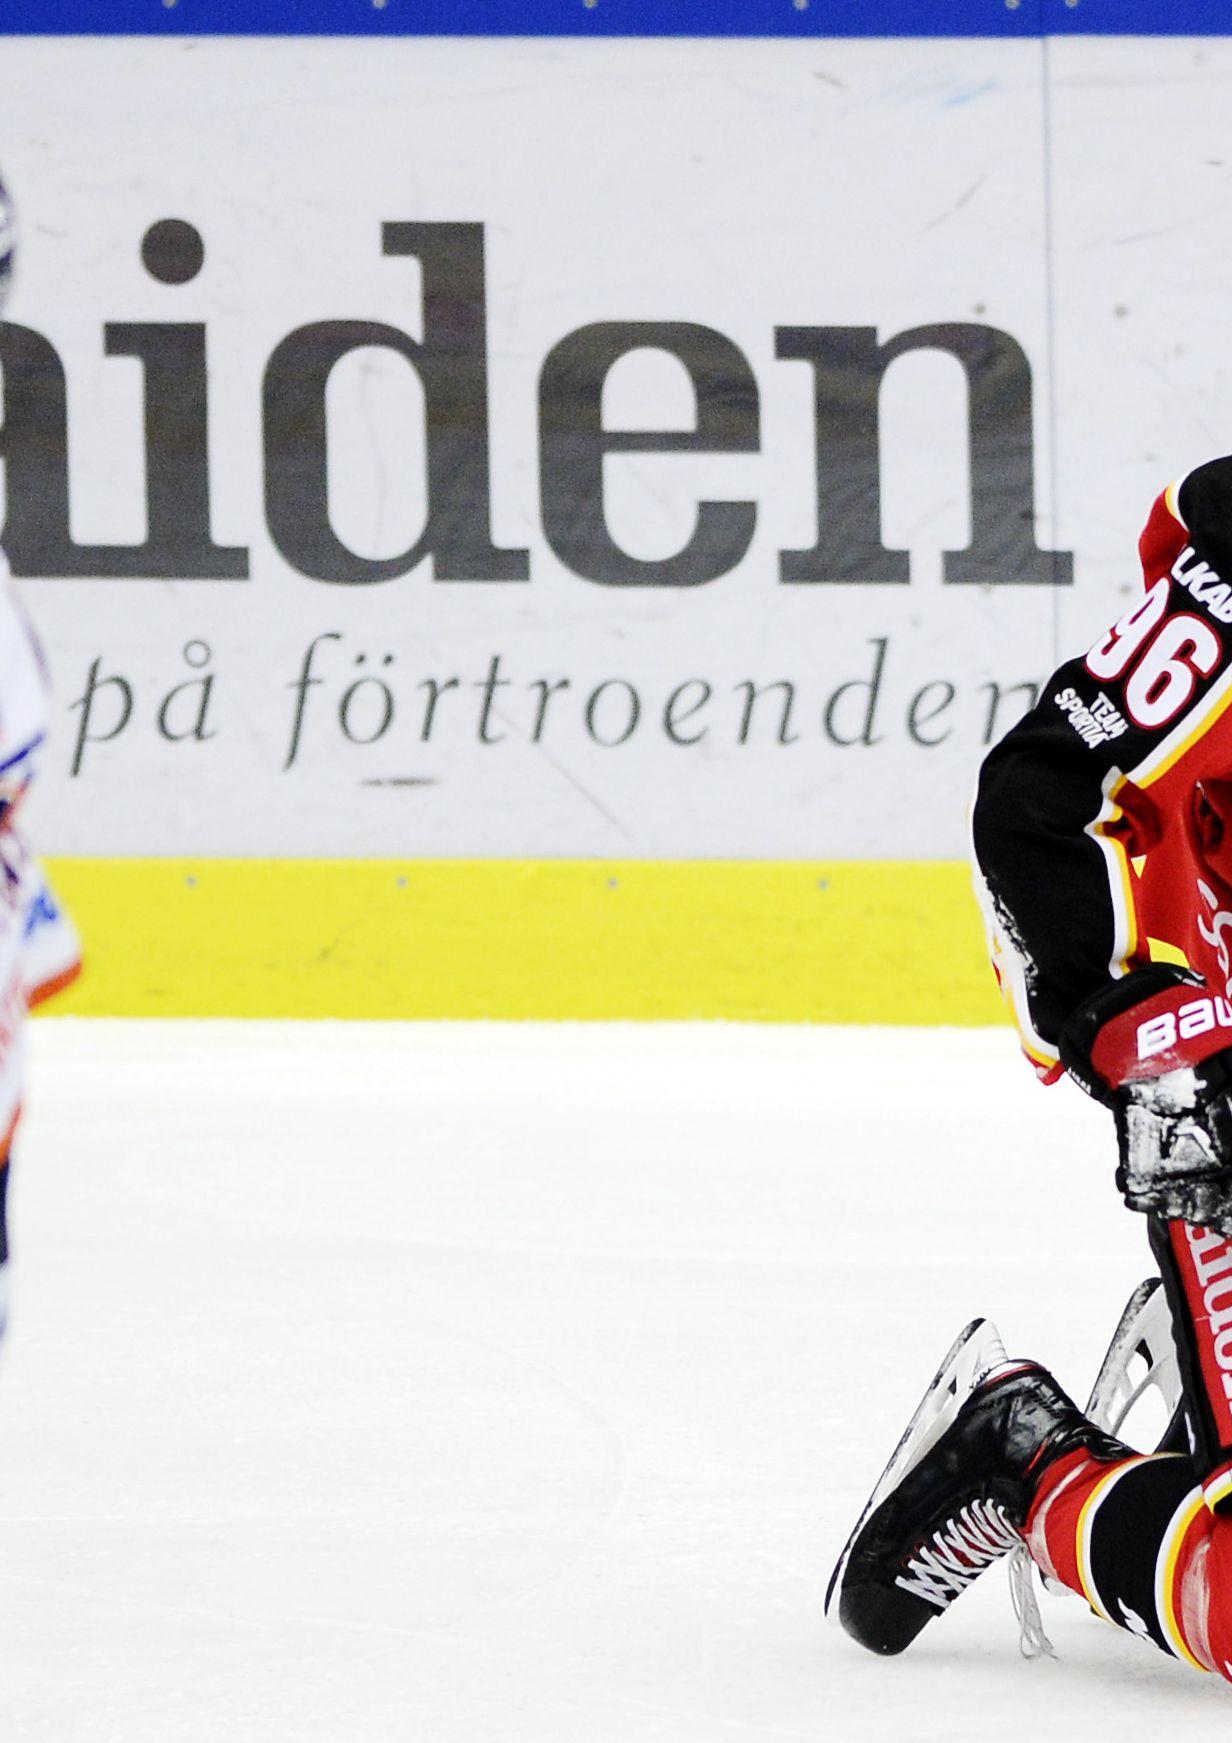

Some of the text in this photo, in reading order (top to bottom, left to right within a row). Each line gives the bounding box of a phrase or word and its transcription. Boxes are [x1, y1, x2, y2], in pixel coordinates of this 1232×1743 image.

[69, 640, 217, 777] på
[1084, 576, 1223, 730] 96
[1089, 691, 1129, 740] TEAM
